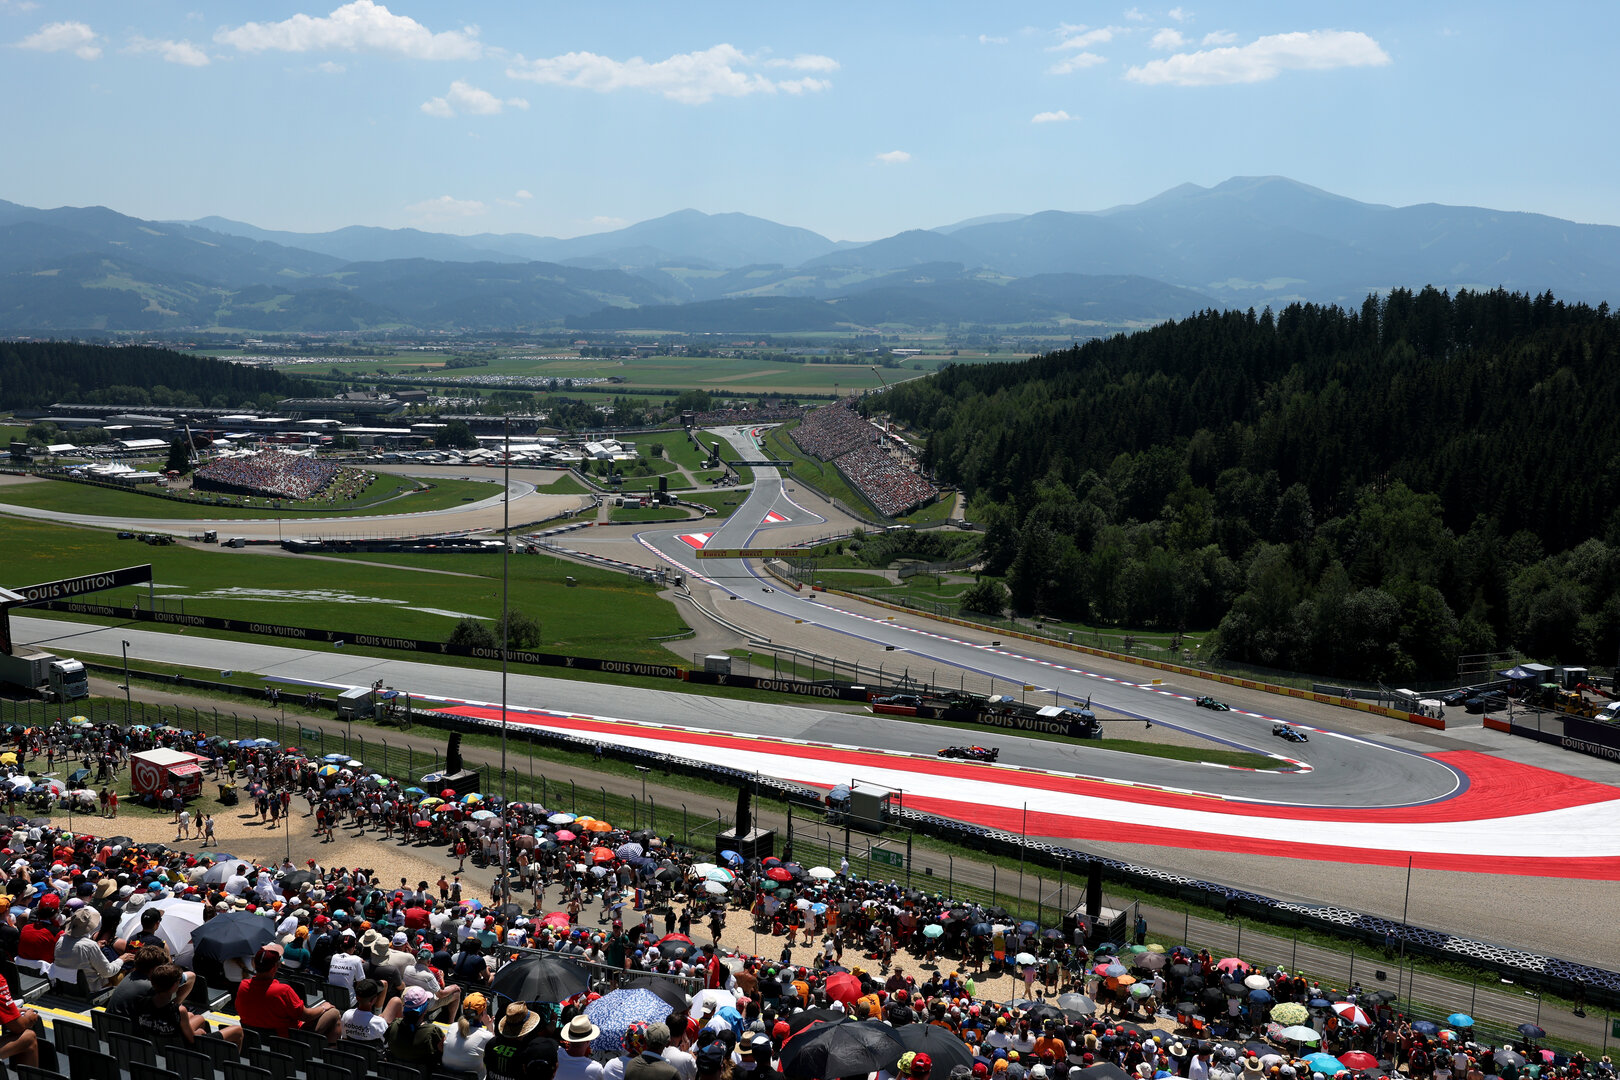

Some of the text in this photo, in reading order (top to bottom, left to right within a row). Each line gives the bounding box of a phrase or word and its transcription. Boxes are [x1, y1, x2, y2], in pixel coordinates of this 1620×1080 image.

[63, 574, 115, 594] VUITTON
[69, 604, 114, 615] LOUIS VUITTON
[154, 613, 205, 625] LOUIS VUITTON
[250, 624, 305, 637] LOUIS VUITTON
[356, 635, 416, 649] LOUIS VUITTON
[472, 647, 499, 658] LOUIS
[601, 661, 676, 676] LOUIS VUITTON
[757, 680, 840, 698] LOUIS VUITTON
[979, 713, 1069, 734] LOUIS VUITTON
[1562, 738, 1584, 750] LOUIS
[493, 1045, 517, 1057] 46
